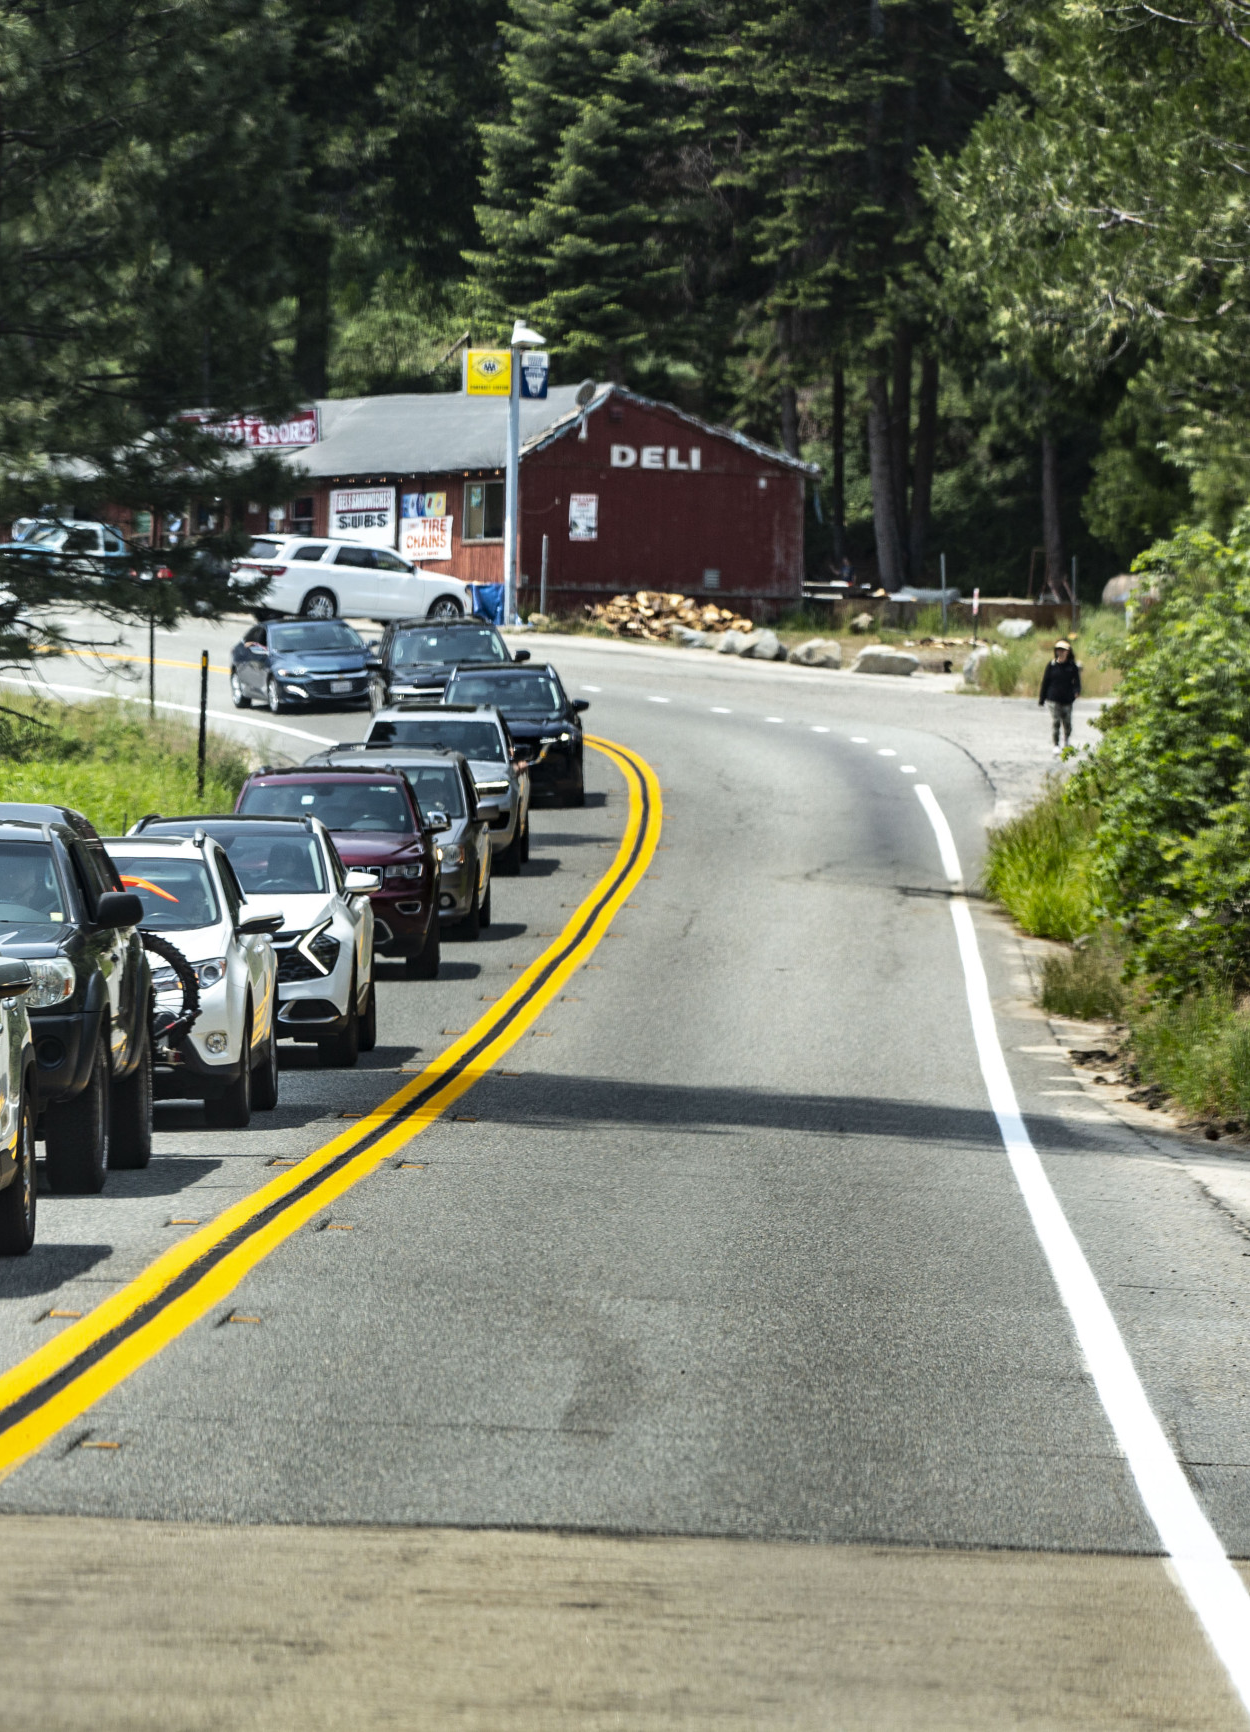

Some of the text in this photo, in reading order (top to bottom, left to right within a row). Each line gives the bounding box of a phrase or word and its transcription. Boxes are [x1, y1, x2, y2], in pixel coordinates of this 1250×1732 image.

[258, 420, 315, 444] STORE
[610, 444, 701, 471] DELI
[352, 491, 391, 510] SANDWICHES
[338, 513, 388, 529] SUBS
[421, 517, 448, 533] TIRE
[406, 533, 447, 549] CHAINS
